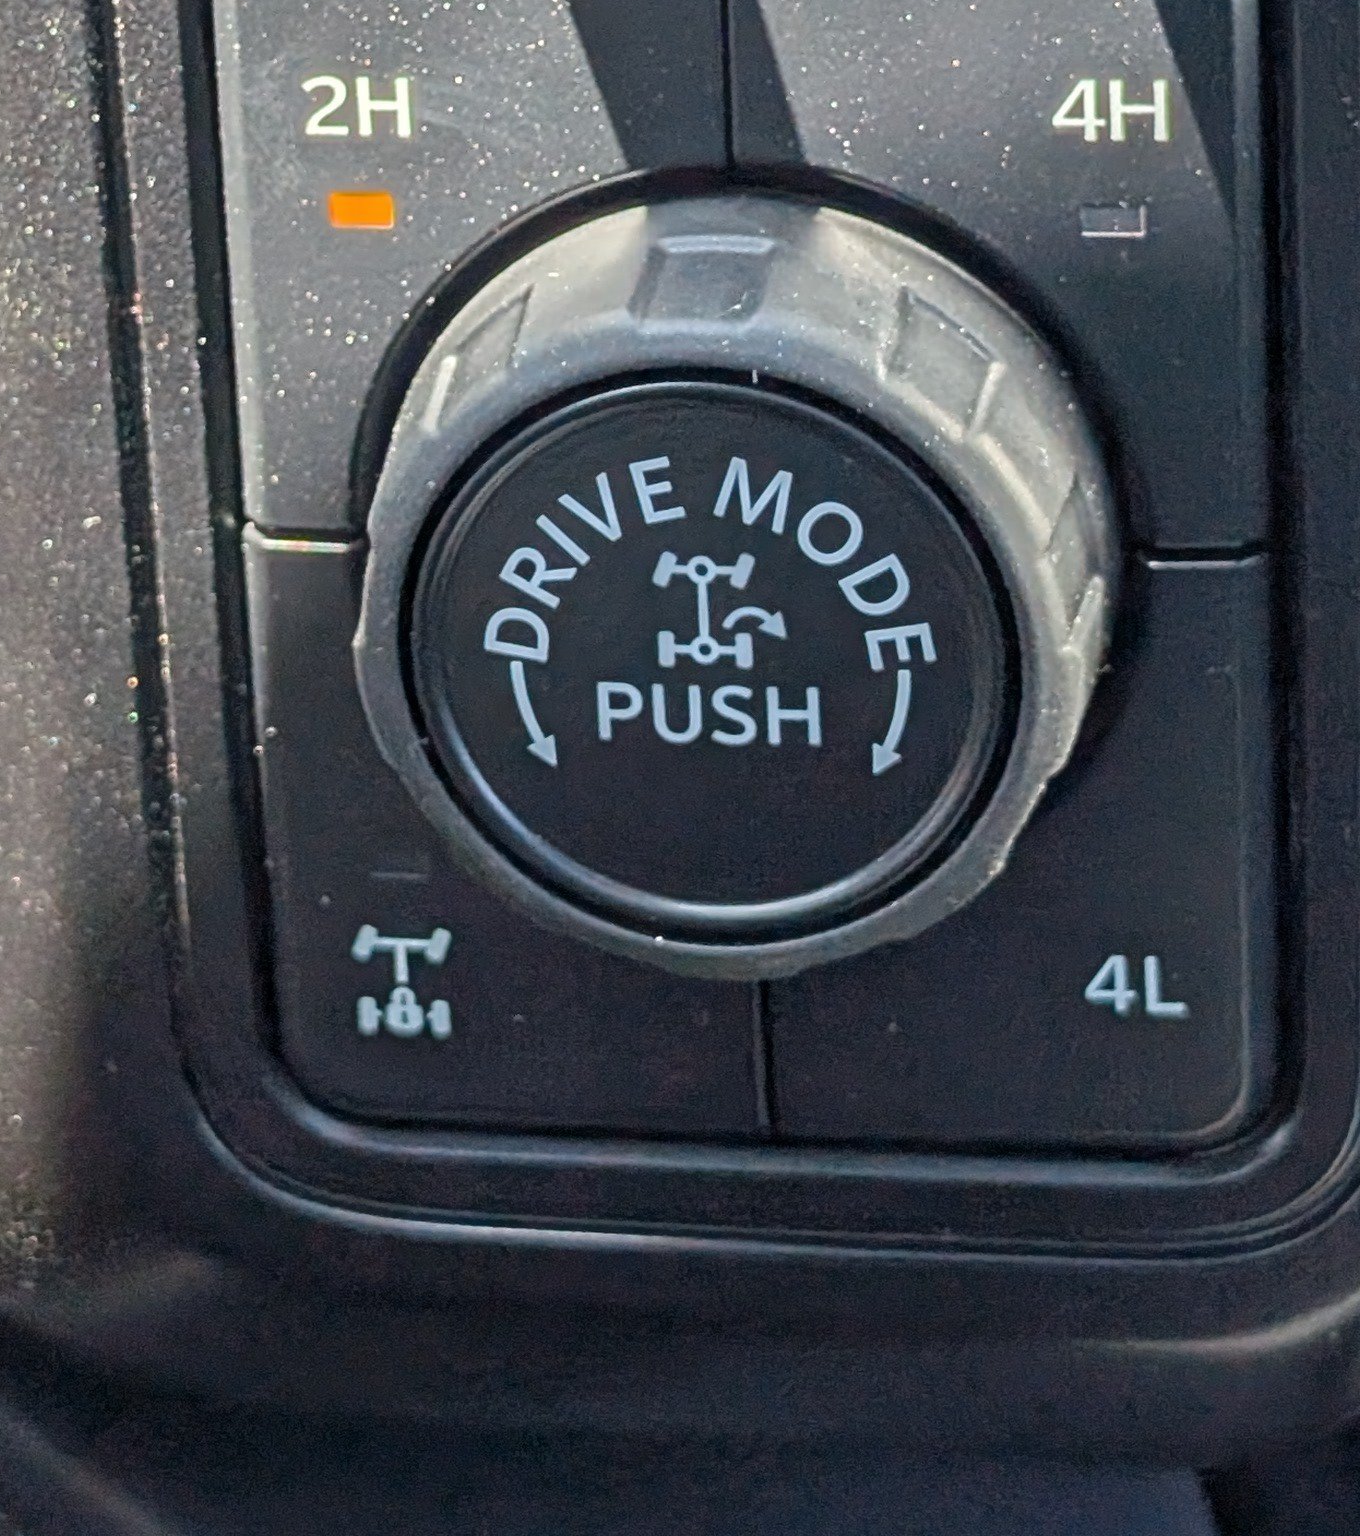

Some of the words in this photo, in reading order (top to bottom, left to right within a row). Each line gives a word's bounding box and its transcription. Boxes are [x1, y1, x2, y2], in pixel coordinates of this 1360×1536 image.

[300, 75, 412, 139] 2H
[1051, 78, 1170, 142] 4H
[483, 455, 687, 664] DRIVE
[712, 456, 937, 672] MODE
[596, 681, 823, 747] PUSH
[1084, 954, 1189, 1017] 4L
